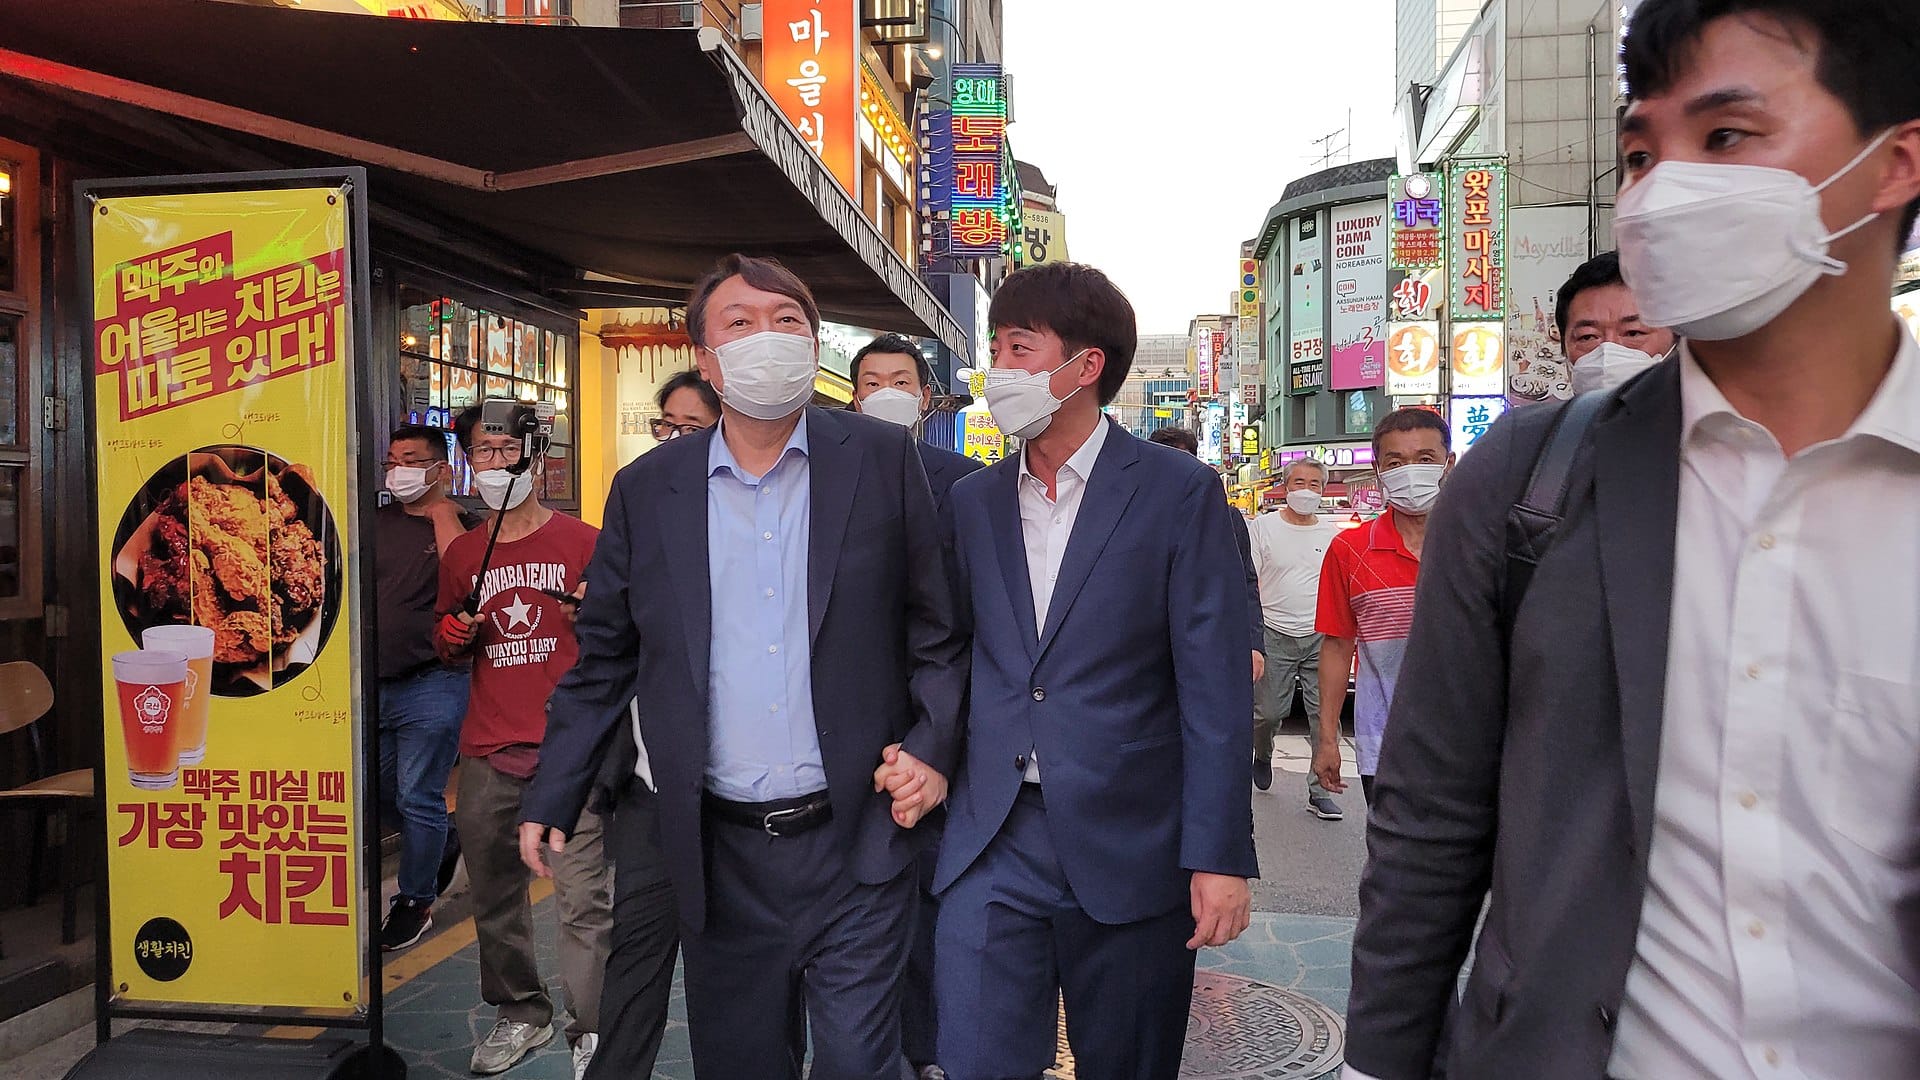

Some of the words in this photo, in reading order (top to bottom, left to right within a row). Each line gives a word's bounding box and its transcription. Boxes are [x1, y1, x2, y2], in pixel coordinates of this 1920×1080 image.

[954, 116, 998, 246] 노래방
[1336, 215, 1382, 233] LUXURY
[1394, 198, 1442, 227] 태국
[1025, 226, 1051, 262] 방
[1336, 230, 1371, 245] HAMA
[1336, 245, 1365, 258] COIN
[121, 247, 225, 304] 맥주와
[1336, 257, 1383, 270] NOREABANG
[1463, 229, 1492, 311] 마사지
[100, 305, 228, 366] 어울리는
[234, 264, 341, 329] 치킨은
[127, 346, 213, 413] 따로
[225, 315, 326, 386] 있다!
[1293, 338, 1323, 360] 당구장
[492, 654, 528, 668] AUTUMN
[183, 769, 240, 801] 맥주
[250, 769, 308, 802] 마실
[318, 770, 346, 803] 때
[118, 802, 206, 849] 가장
[219, 803, 348, 853] 맛있는
[219, 853, 350, 926] 치킨
[136, 939, 193, 960] 생활치킨
